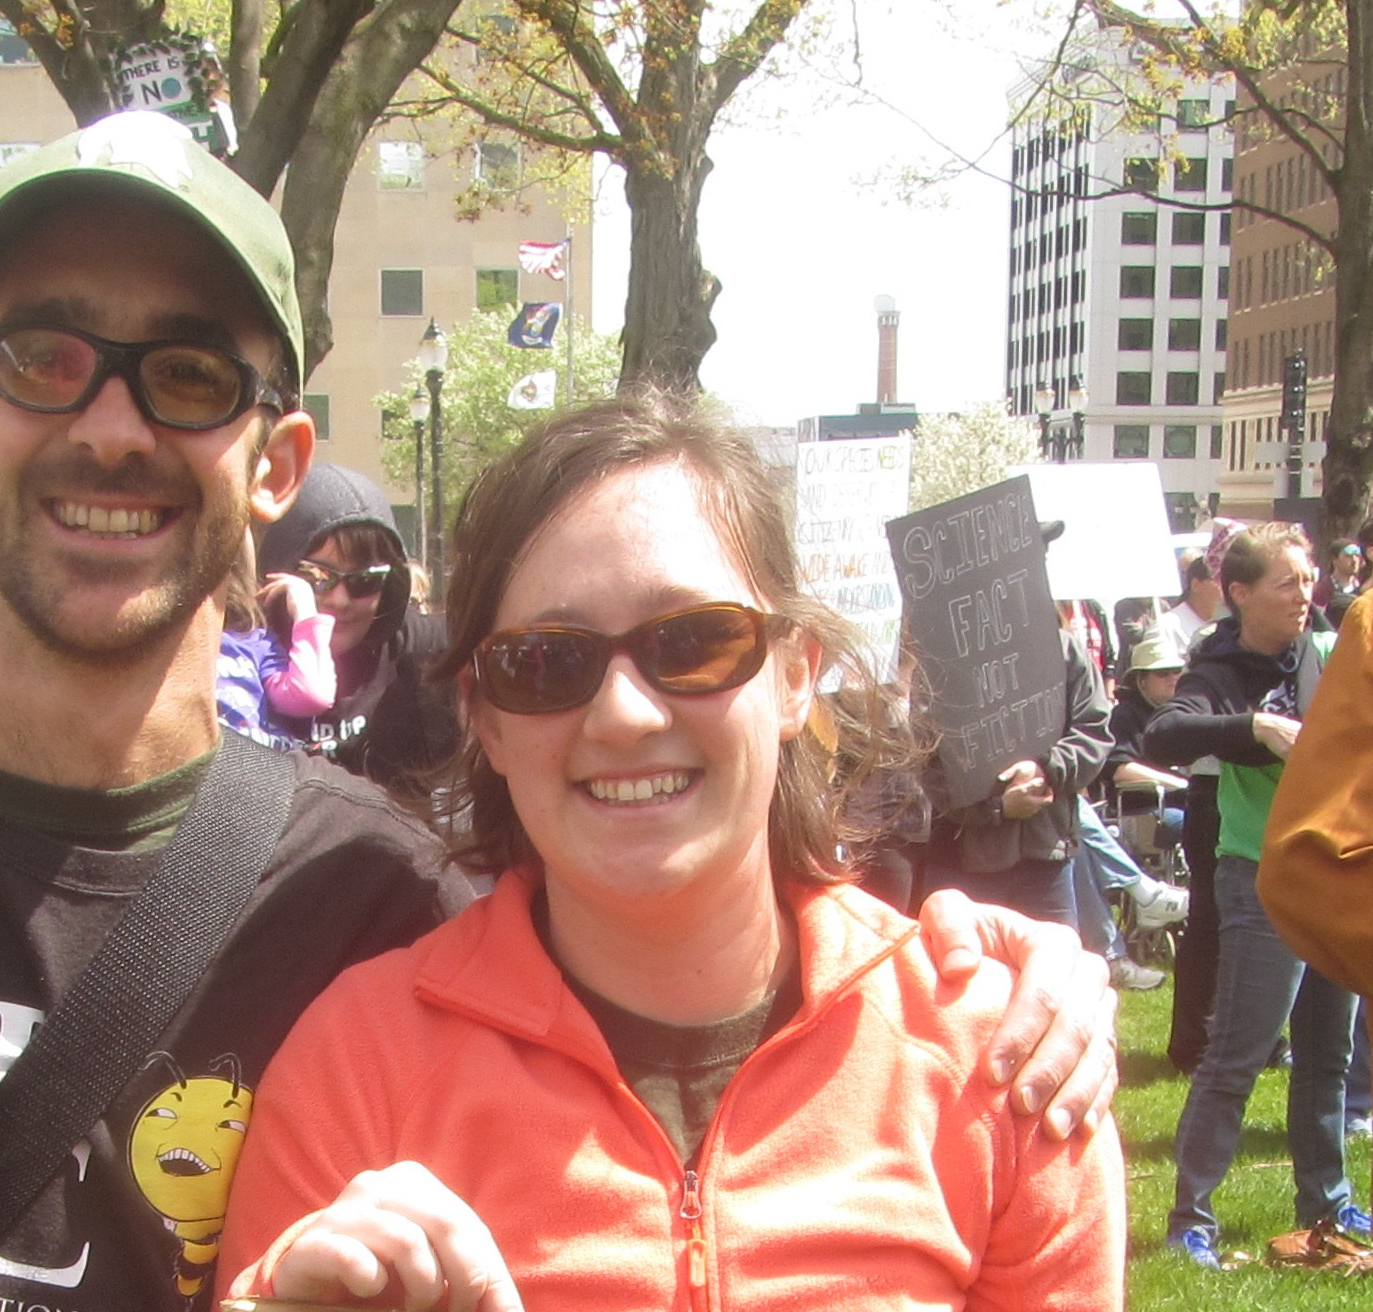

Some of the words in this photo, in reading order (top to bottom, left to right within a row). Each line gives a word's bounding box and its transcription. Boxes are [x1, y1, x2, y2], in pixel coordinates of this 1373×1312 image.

[168, 56, 180, 69] IS
[902, 491, 1033, 599] SCIENCE
[947, 568, 1032, 658] FACT
[975, 652, 1021, 708] NOT
[960, 682, 1065, 772] FICTION
